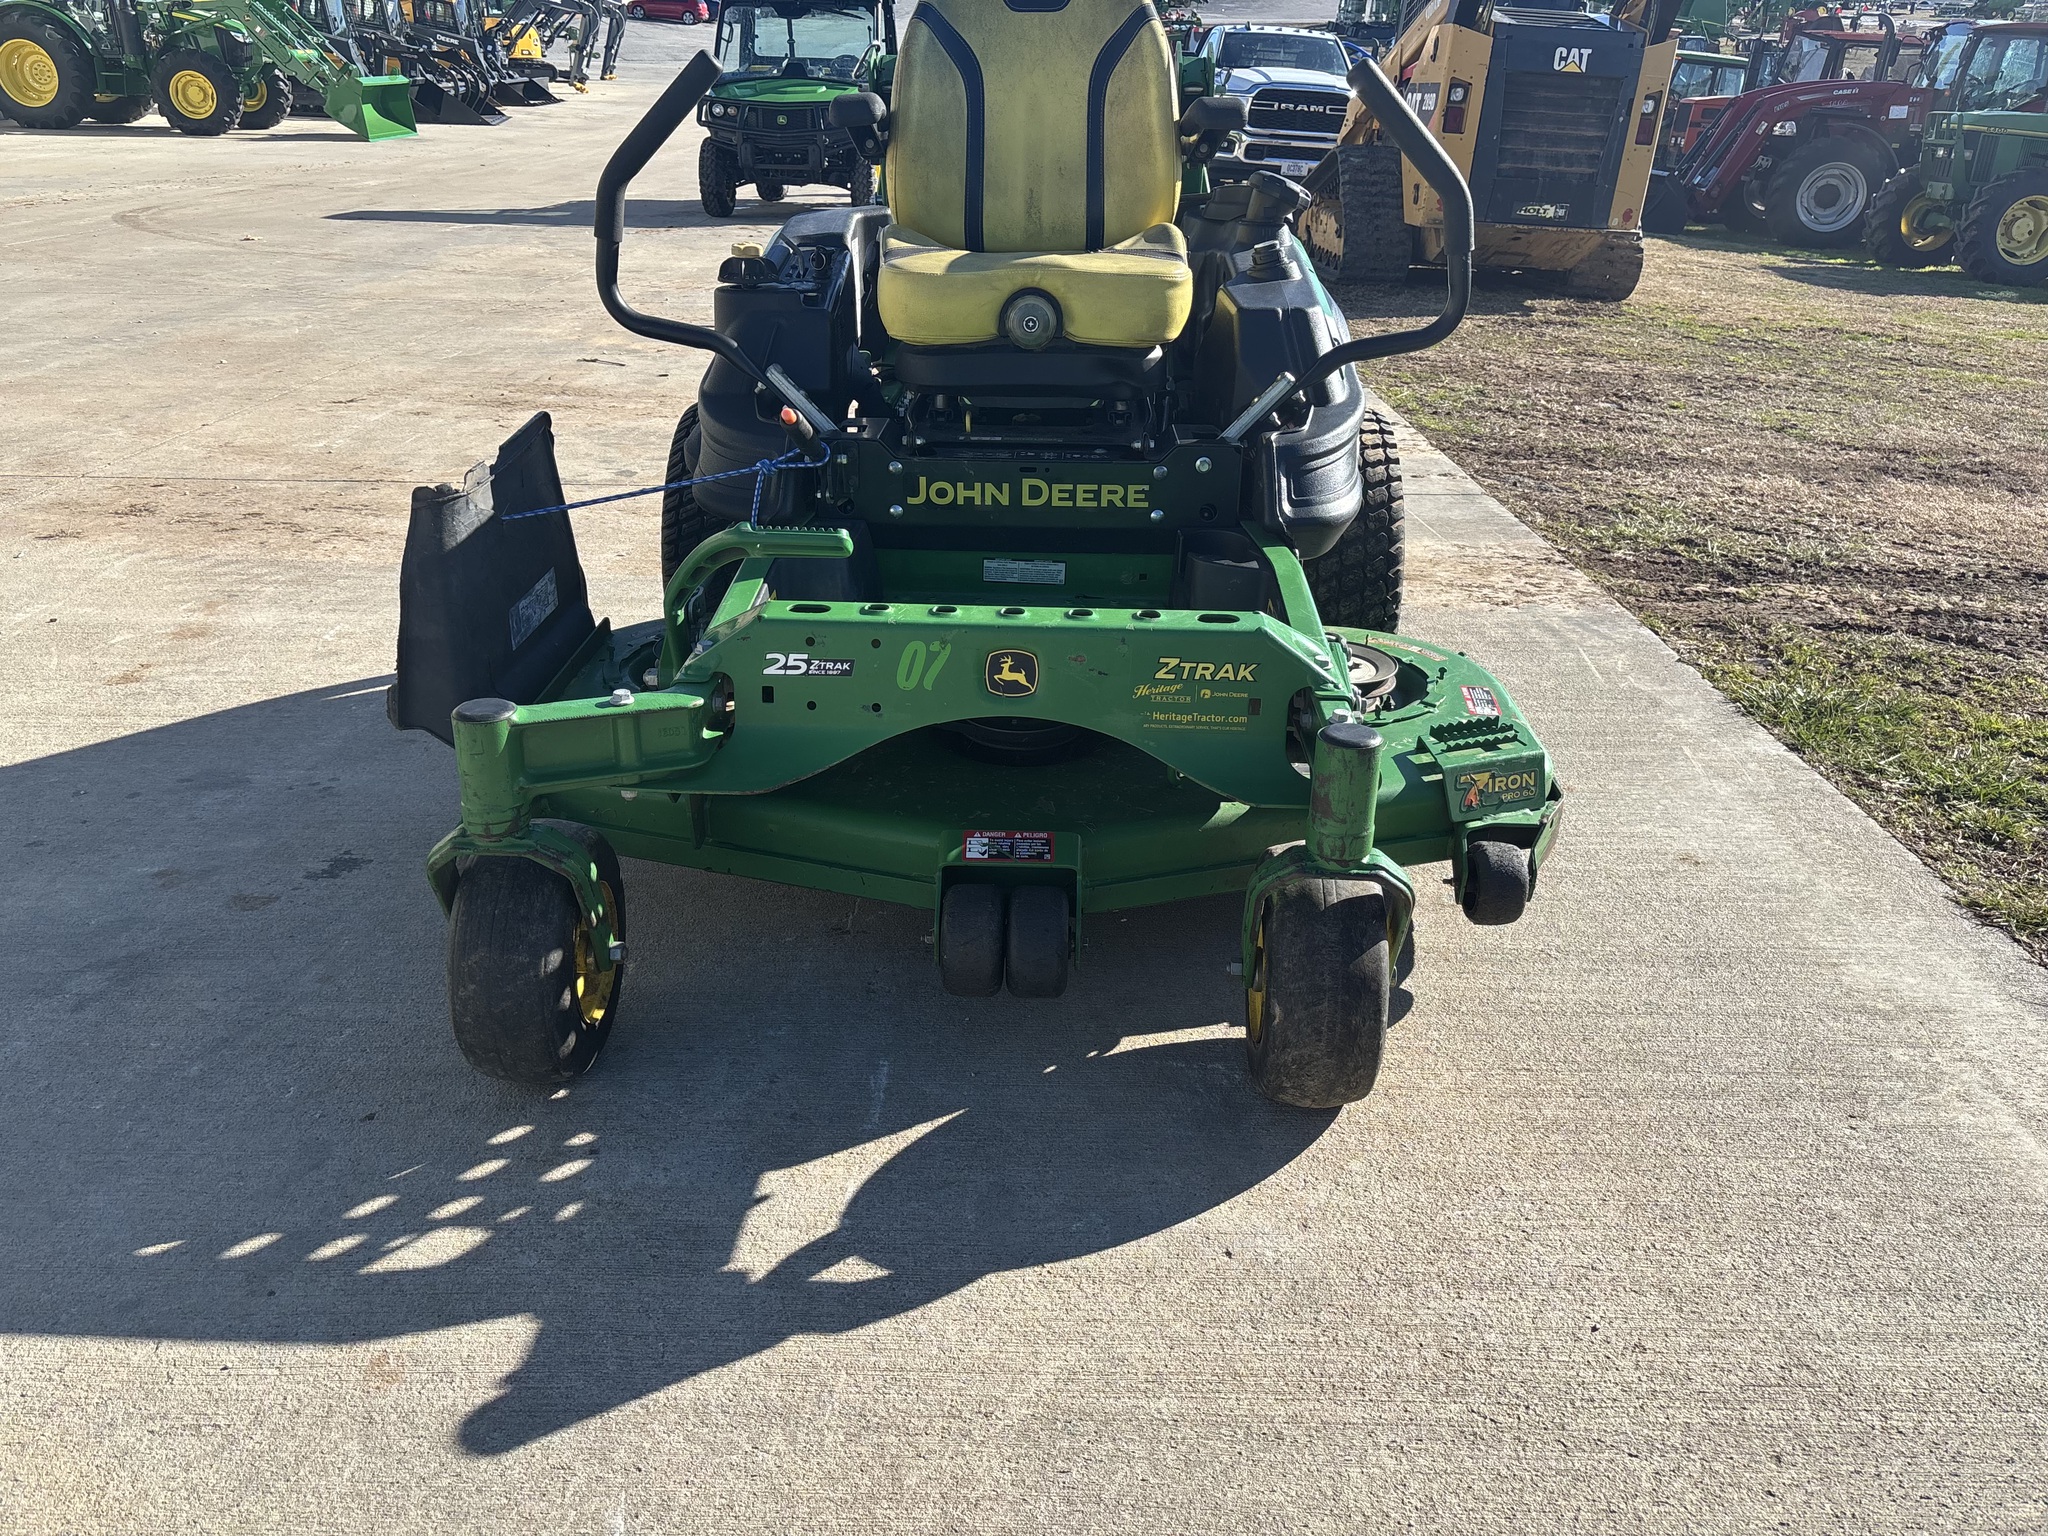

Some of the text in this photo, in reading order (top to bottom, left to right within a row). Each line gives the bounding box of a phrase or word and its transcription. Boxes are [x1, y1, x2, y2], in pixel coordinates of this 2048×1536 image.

[436, 33, 460, 45] DEERE
[1553, 46, 1593, 74] CAT
[1280, 103, 1325, 112] RAM
[1519, 207, 1550, 215] HOLT
[906, 476, 1150, 508] JOHN DEERE
[762, 653, 851, 675] 25 ZTRAK
[896, 640, 951, 691] 07
[1154, 656, 1259, 682] ZTRAK
[1132, 683, 1184, 699] Heritage
[1152, 711, 1248, 723] HeritageTractor.com
[1502, 788, 1535, 800] PRO 60
